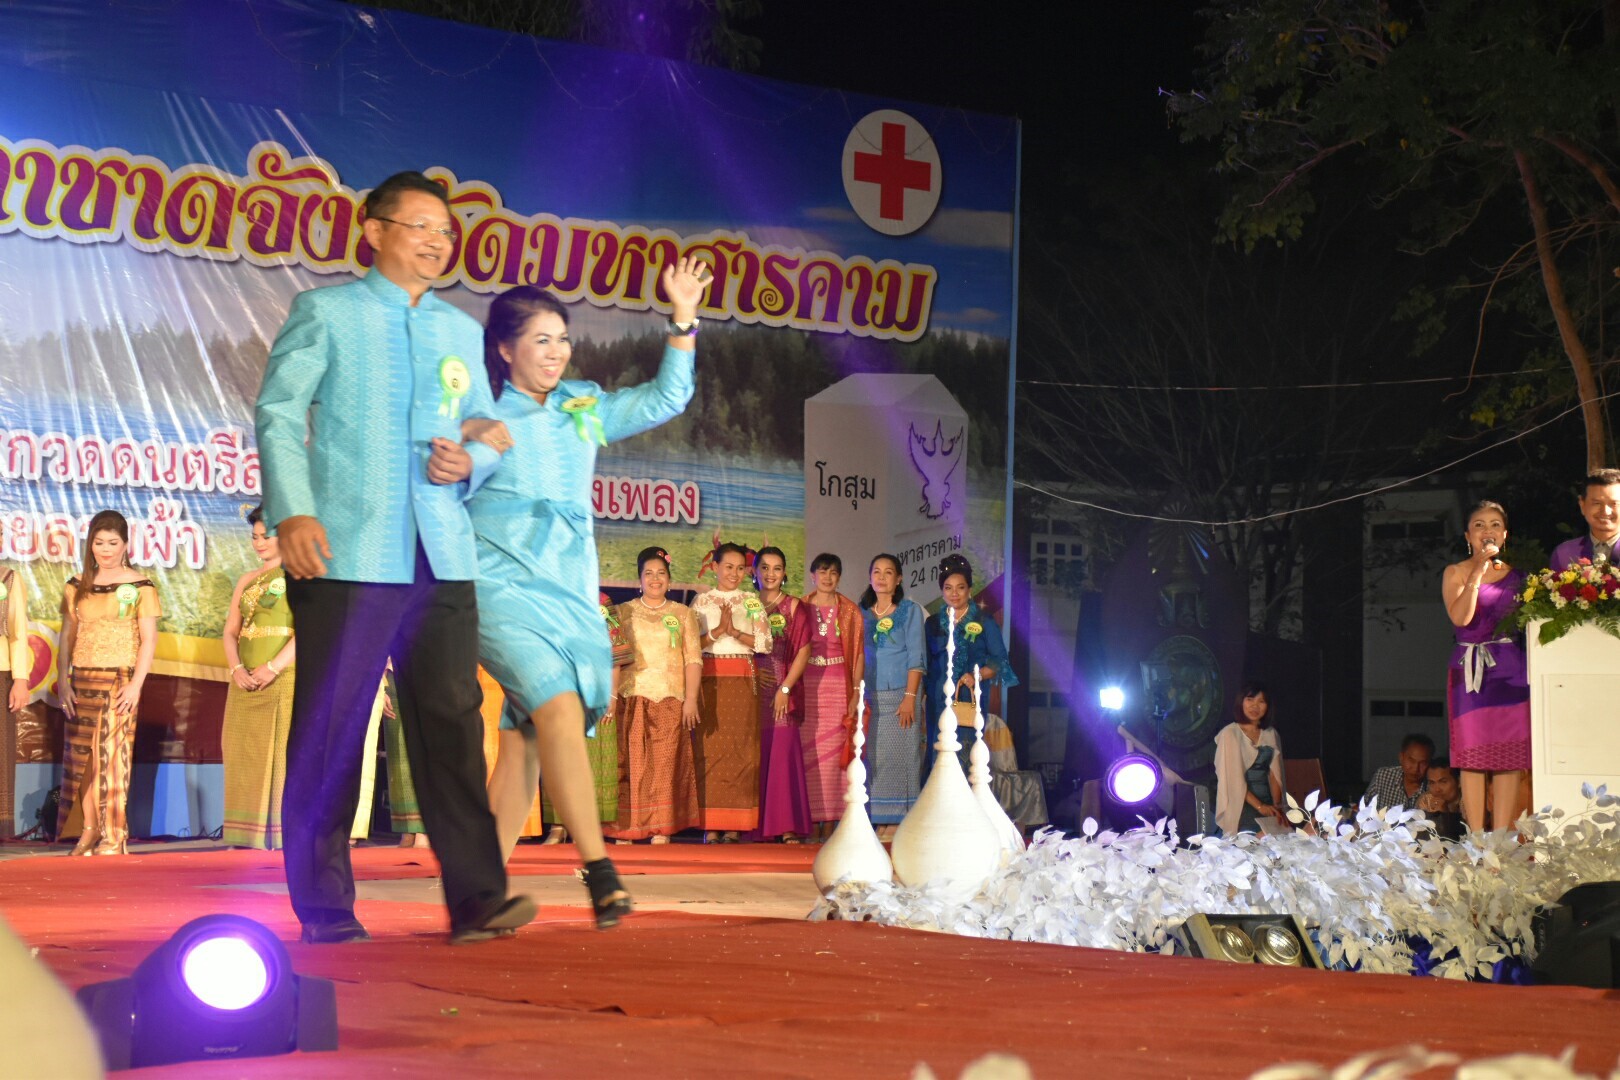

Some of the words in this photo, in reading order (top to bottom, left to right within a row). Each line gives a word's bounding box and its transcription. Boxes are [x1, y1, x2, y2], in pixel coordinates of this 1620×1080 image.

[814, 460, 876, 511] โกสุม
[896, 533, 961, 567] หาสารคาม
[909, 567, 926, 589] 24
